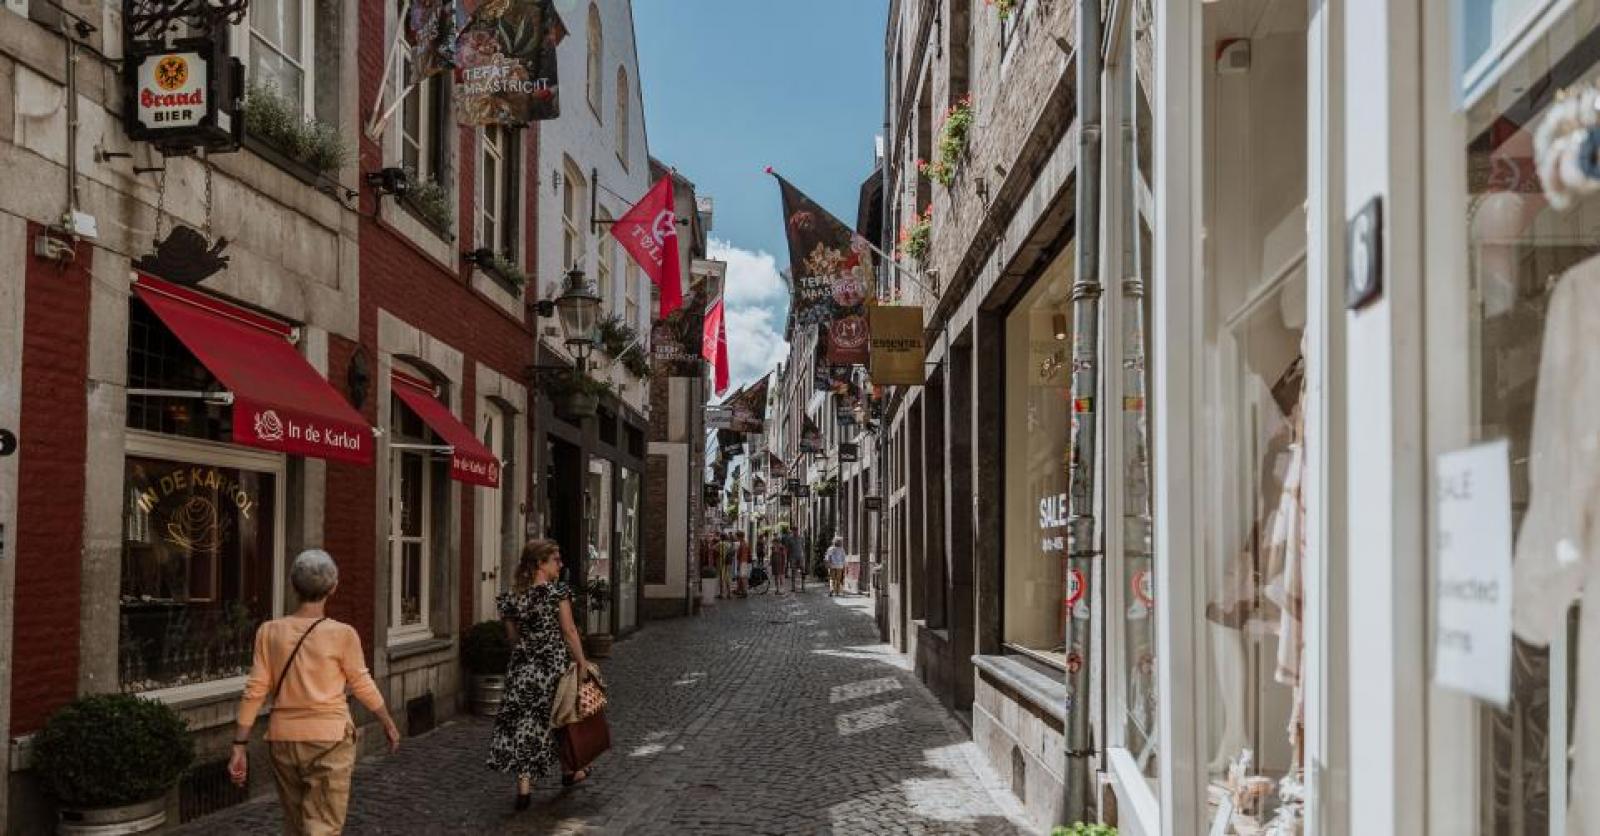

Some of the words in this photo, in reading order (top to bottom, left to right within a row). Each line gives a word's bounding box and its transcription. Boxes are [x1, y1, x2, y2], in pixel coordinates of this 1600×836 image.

[463, 66, 510, 81] TEFAF
[141, 87, 204, 108] Brand
[153, 109, 193, 122] BIER
[1352, 214, 1368, 293] 6
[288, 420, 300, 439] In
[305, 424, 320, 442] de
[324, 428, 360, 451] Karkol
[138, 486, 160, 513] IN
[161, 469, 187, 496] DE
[1040, 493, 1067, 528] SALE
